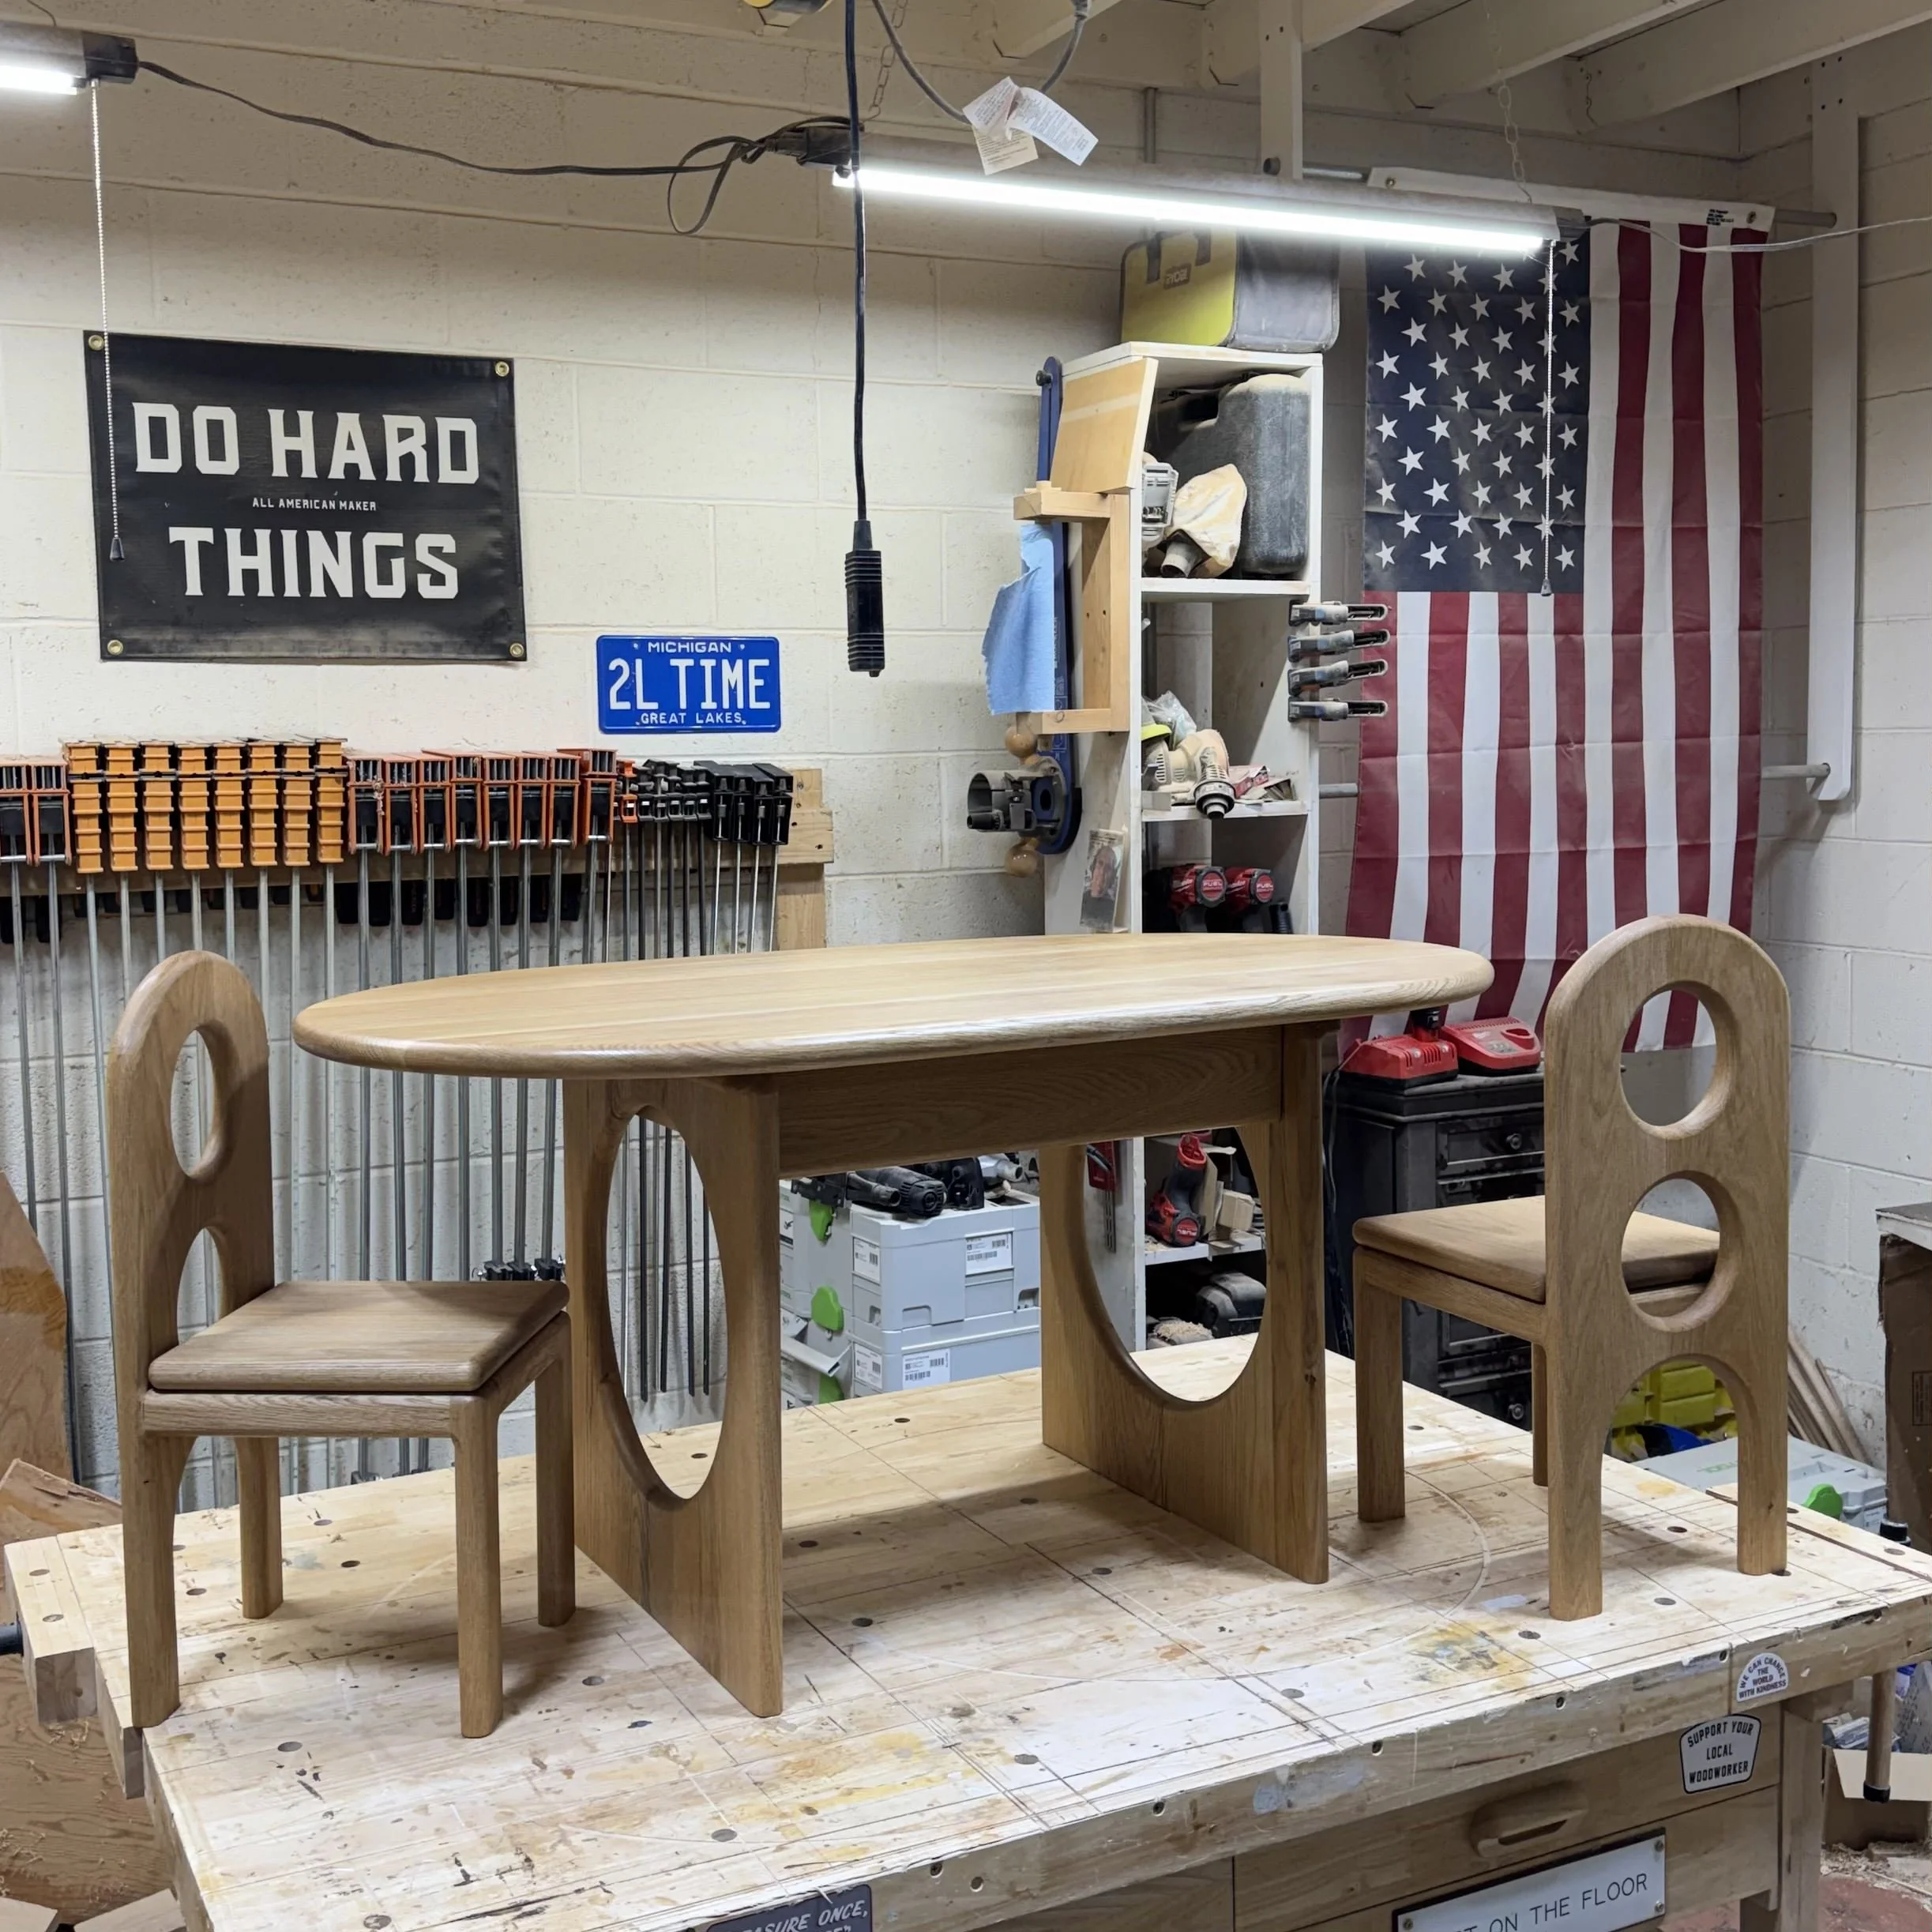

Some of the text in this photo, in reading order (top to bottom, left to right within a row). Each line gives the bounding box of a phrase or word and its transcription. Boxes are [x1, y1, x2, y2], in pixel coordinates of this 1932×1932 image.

[132, 402, 479, 484] DO HARD
[252, 498, 377, 512] ALL AMERICAN MAKER
[168, 527, 458, 600] THINGS
[648, 641, 731, 653] MICHIGAN
[608, 657, 771, 710] 2L TIME
[641, 712, 742, 724] GREAT LAKES
[1740, 1657, 1785, 1688] WE CAN CHANGE
[1753, 1675, 1773, 1686] WORLD
[1757, 1667, 1768, 1675] THE
[1739, 1679, 1787, 1698] WITH KINDNESS
[1687, 1721, 1753, 1748] SUPPORT YOUR
[1706, 1743, 1733, 1761] LOCAL
[1689, 1760, 1749, 1784] WOODWORKER
[818, 1900, 868, 1926] ONCE,
[1490, 1873, 1648, 1932] ON THE FLOOR
